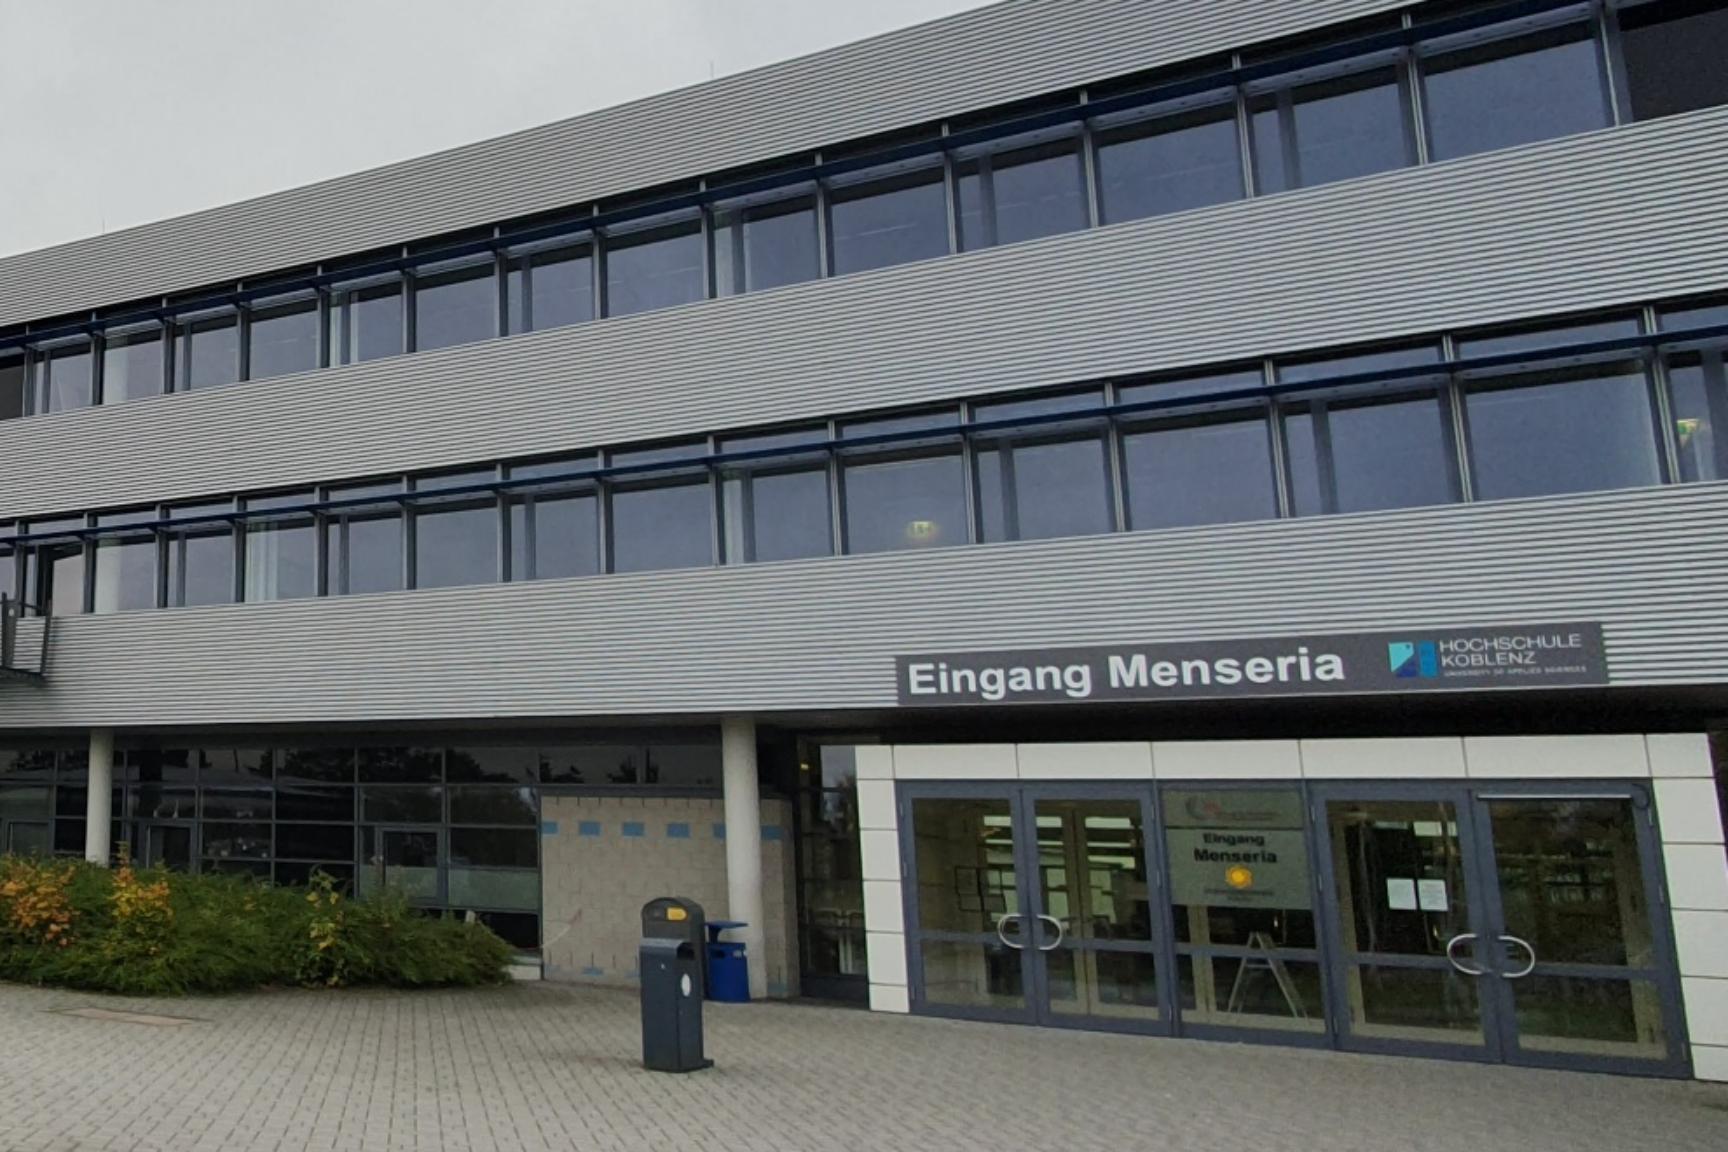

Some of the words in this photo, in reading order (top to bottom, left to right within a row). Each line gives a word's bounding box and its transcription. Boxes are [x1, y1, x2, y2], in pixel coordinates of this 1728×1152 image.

[1440, 633, 1582, 652] HOCHSCHULE
[1441, 652, 1537, 667] KOBLENZ
[908, 662, 1091, 699] Eingang
[1107, 647, 1345, 688] Menseria
[1203, 832, 1265, 846] Eingang
[1194, 848, 1278, 863] Menseria
